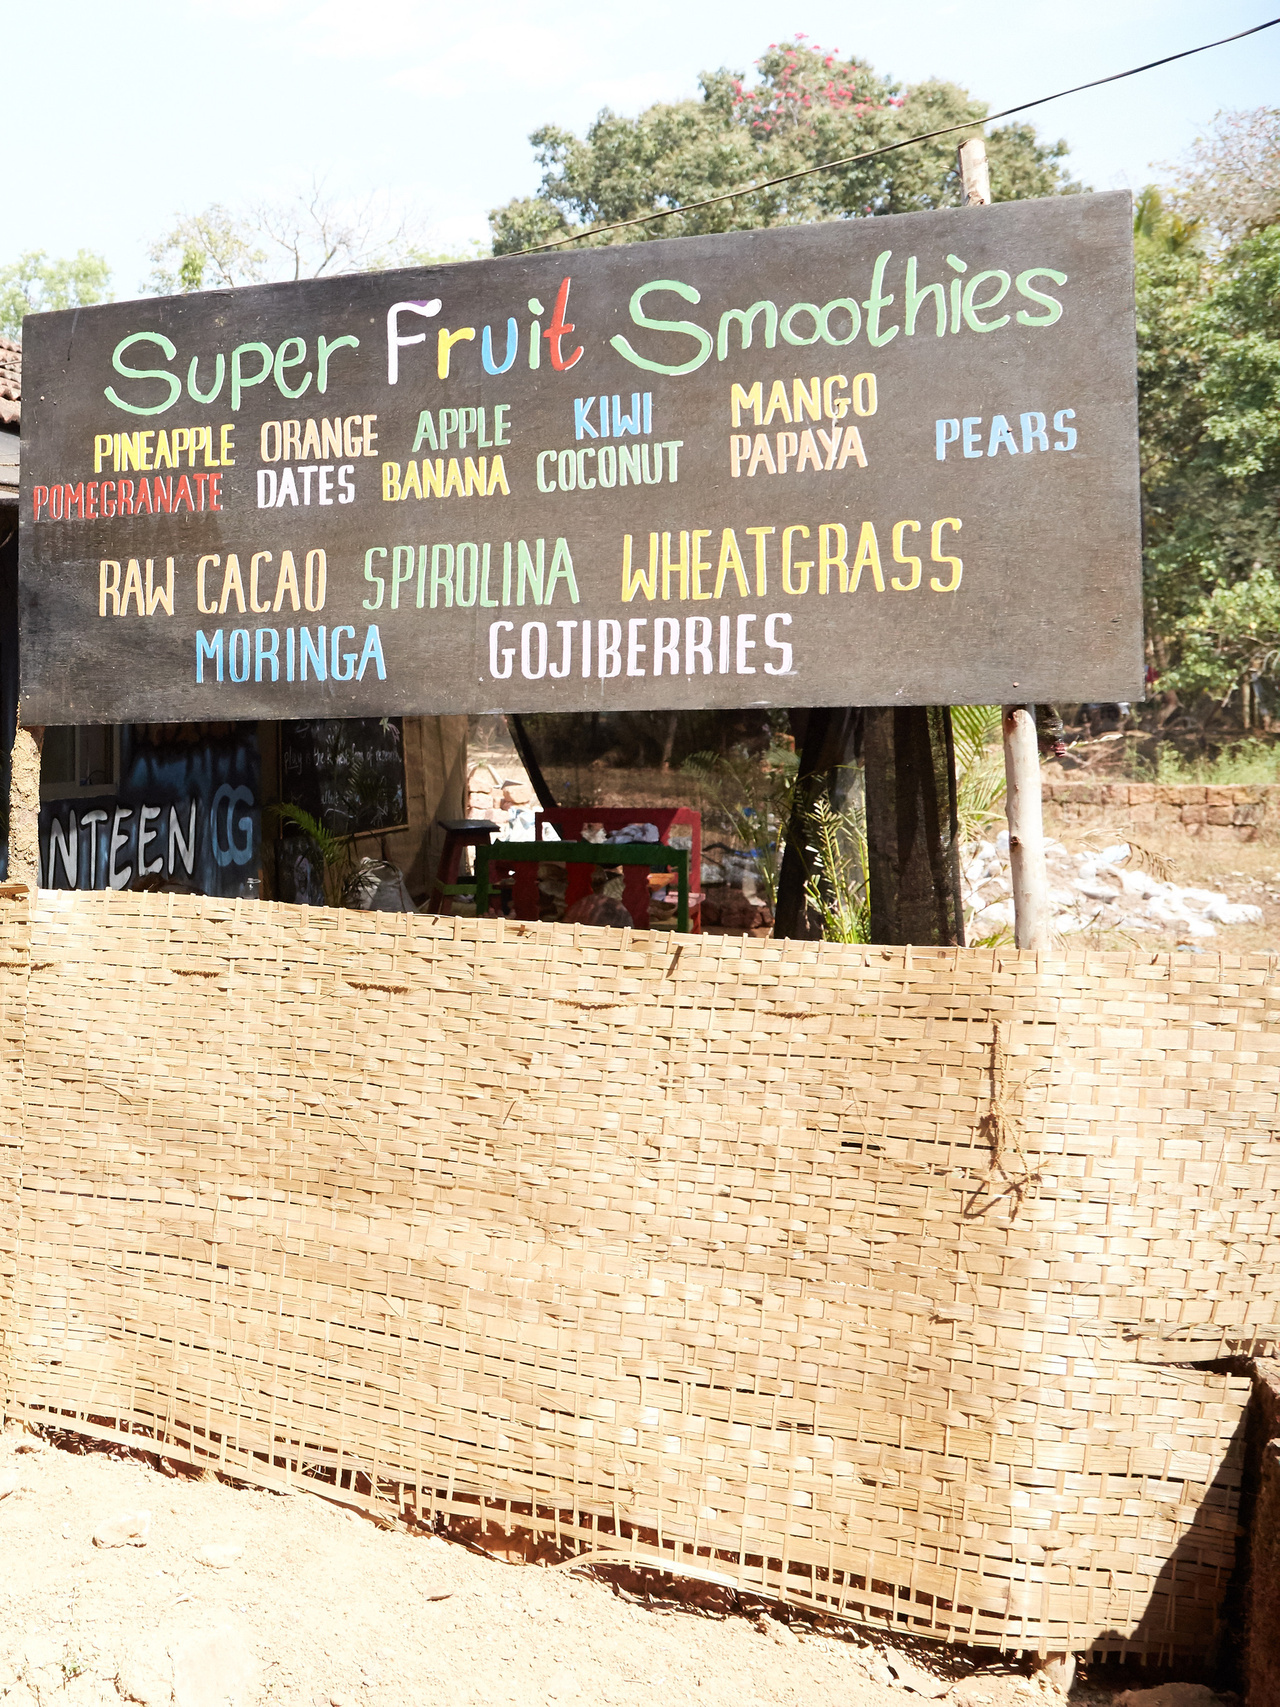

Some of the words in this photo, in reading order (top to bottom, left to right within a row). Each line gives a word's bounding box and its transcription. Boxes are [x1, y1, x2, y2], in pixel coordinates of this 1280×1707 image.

[104, 331, 360, 415] Super
[387, 276, 585, 385] Fruit
[610, 250, 1068, 376] Smoothies
[94, 424, 235, 473] PINEAPPLE
[260, 414, 379, 463] ORANGE
[412, 404, 512, 452] APPLE
[574, 392, 653, 440] KIWI
[731, 373, 879, 427] MANGO
[936, 409, 1078, 460] PEARS
[33, 473, 224, 520] POMEGRANATE
[257, 465, 356, 508] DATES
[382, 455, 511, 502] BANANA
[537, 440, 683, 492] COCONUT
[730, 426, 869, 477] PAPAYA
[99, 556, 175, 617] RAW
[197, 549, 327, 614] CACAO
[363, 538, 580, 610] SPIROLINA
[621, 517, 963, 602] WHEATGRASS
[195, 624, 387, 684] MORINGA
[488, 612, 794, 680] GOJIBERRIES
[48, 797, 197, 891] NTEEN
